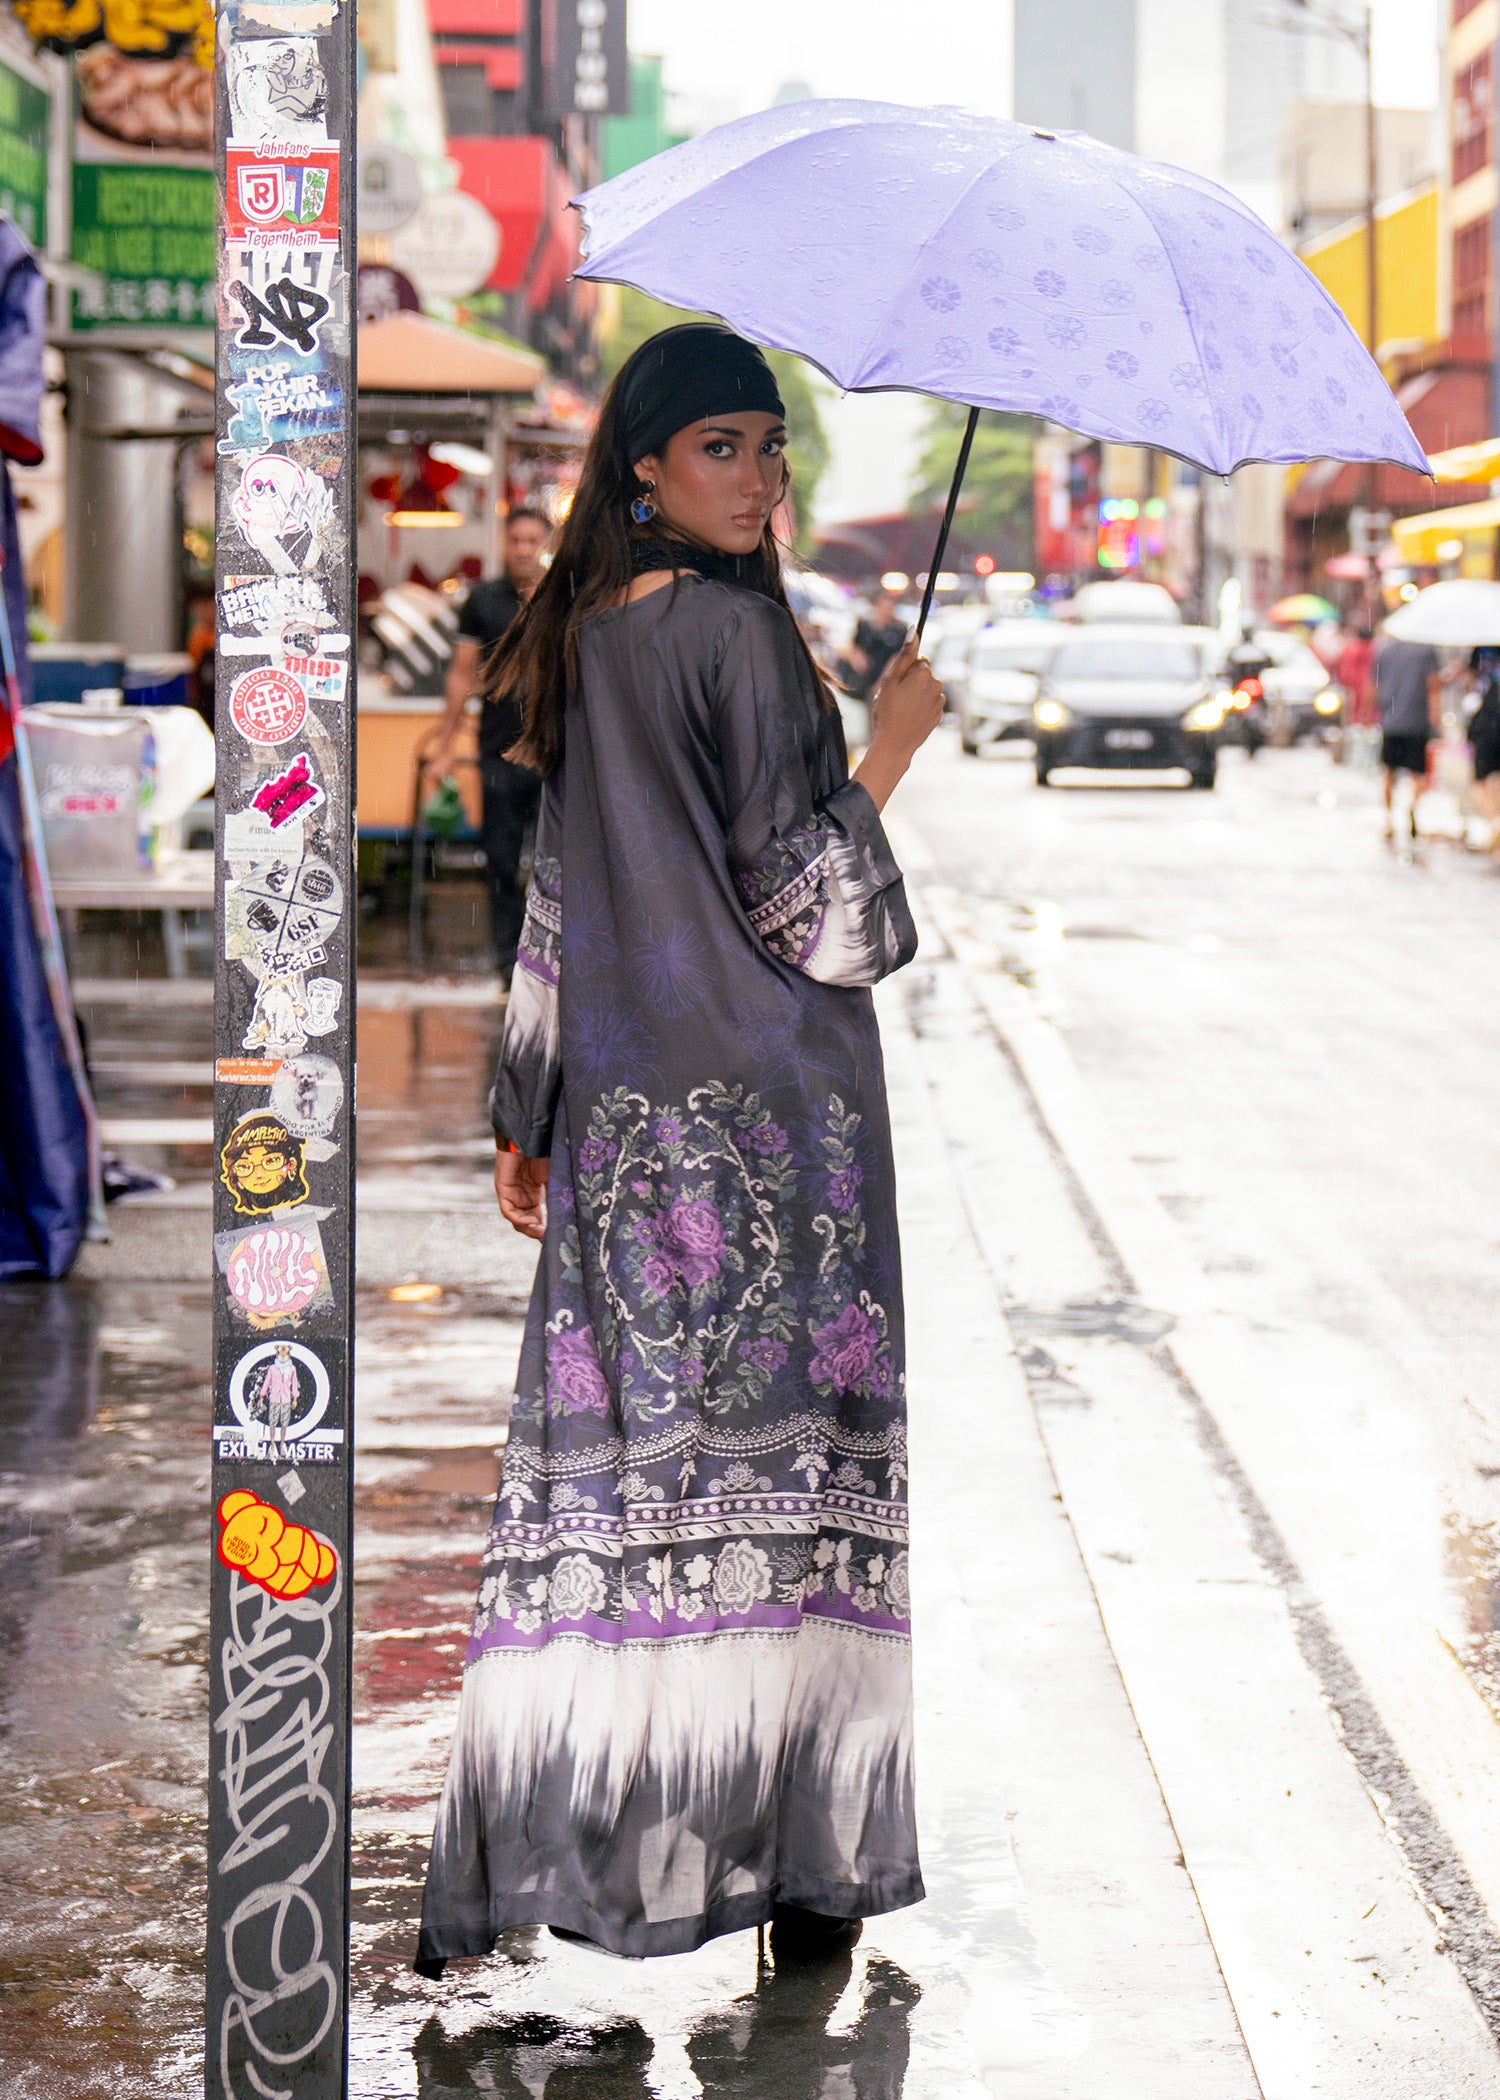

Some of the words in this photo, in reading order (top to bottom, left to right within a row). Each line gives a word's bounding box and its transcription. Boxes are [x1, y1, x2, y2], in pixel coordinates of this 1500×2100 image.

[256, 141, 310, 156] Jahnfans
[247, 229, 318, 249] Tegernheim
[245, 361, 292, 385] POP
[234, 669, 270, 711] CODIGO
[275, 670, 300, 694] 1530
[268, 702, 305, 741] CODIGO
[289, 1127, 331, 1138] ARGENTINA
